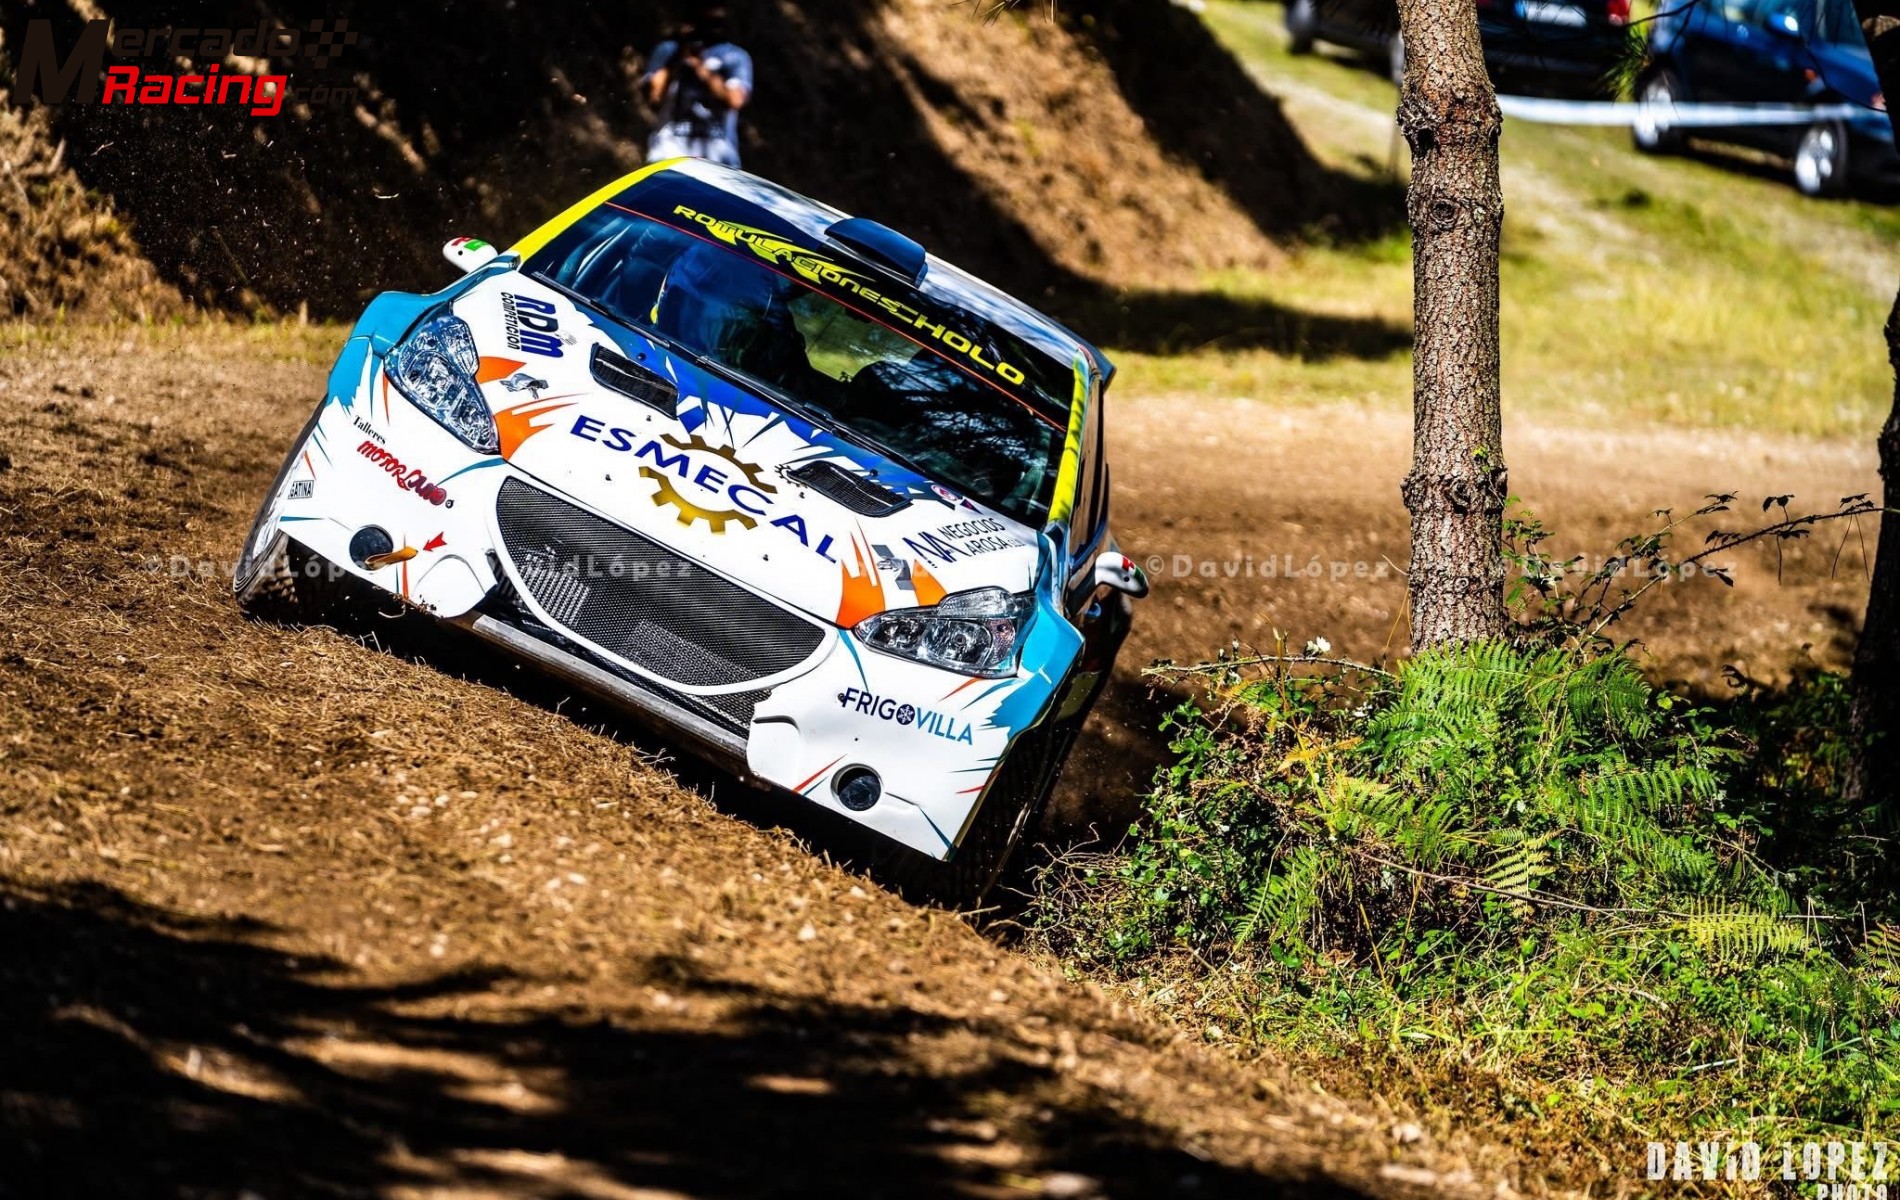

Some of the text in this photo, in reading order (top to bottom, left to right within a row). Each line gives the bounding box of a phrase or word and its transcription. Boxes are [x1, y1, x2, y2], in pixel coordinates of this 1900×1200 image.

[501, 291, 520, 350] COMPETICION
[353, 415, 386, 445] Talleres
[570, 414, 838, 564] ESMECAL
[937, 517, 1006, 541] NEGOCIOS
[963, 536, 1010, 556] AROSA
[842, 687, 973, 746] FRIGOVILLA
